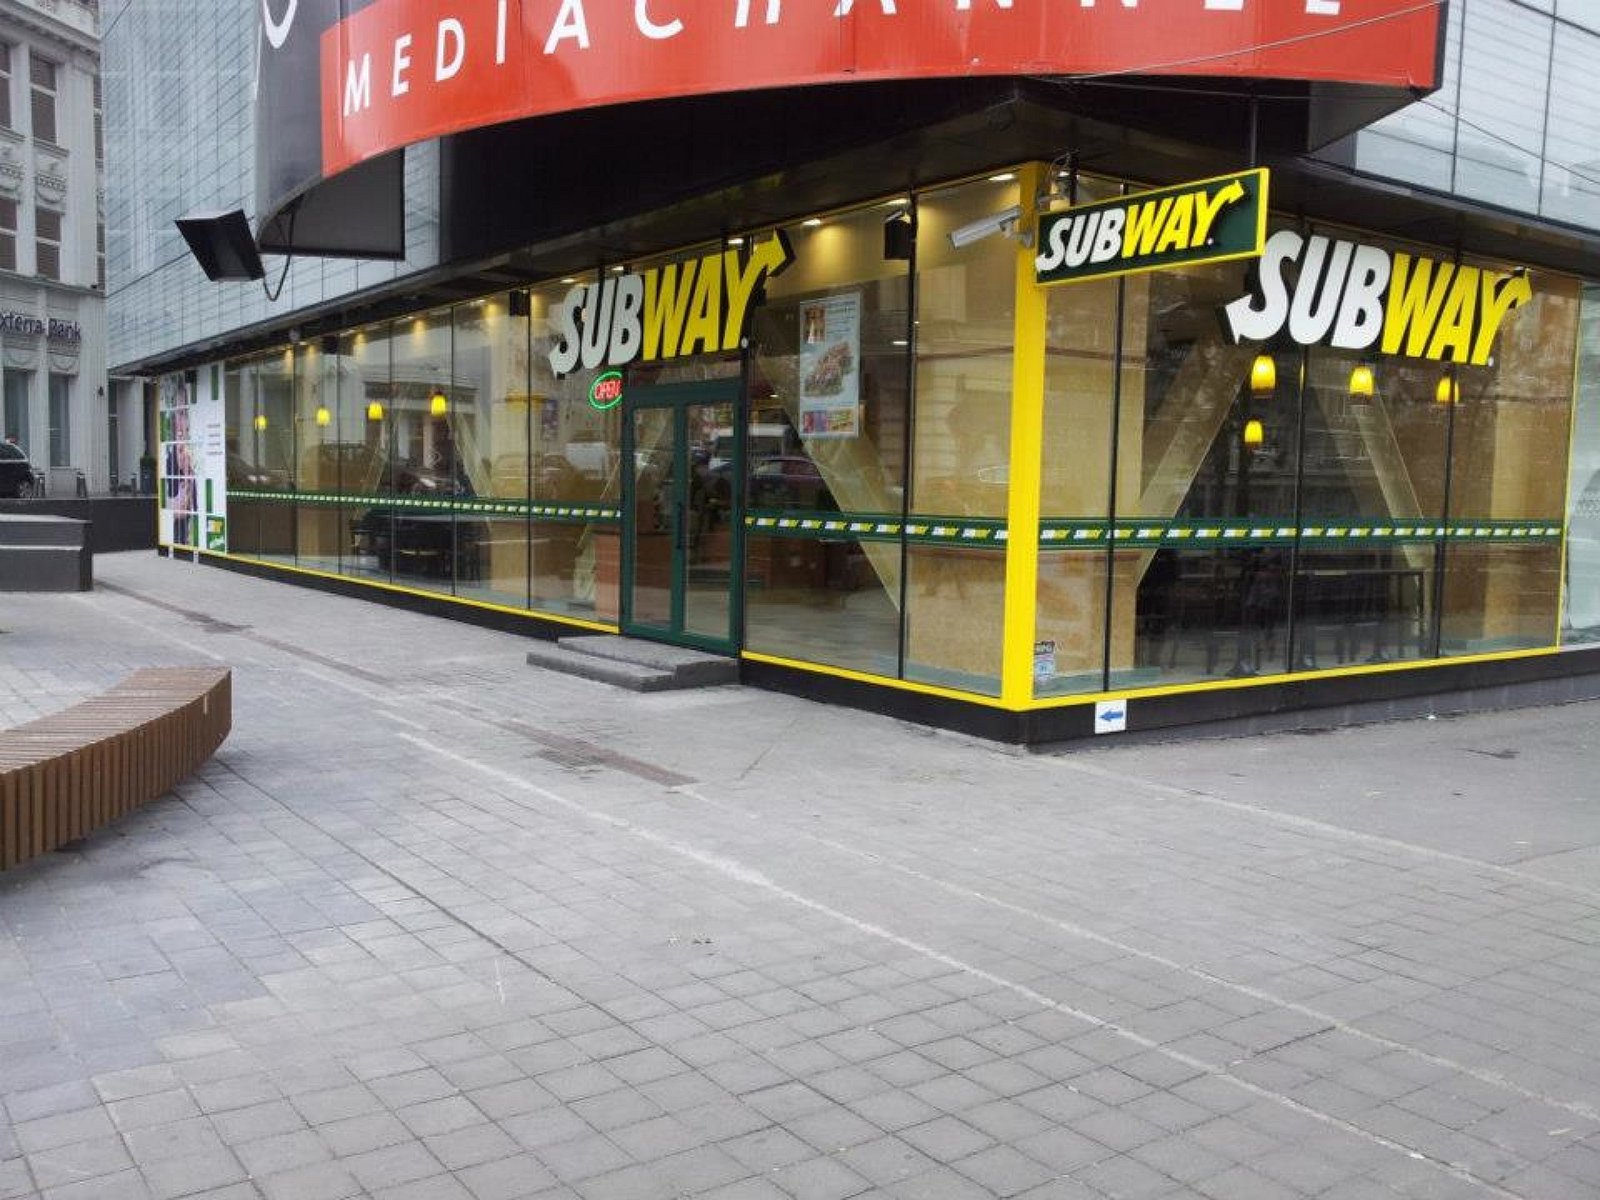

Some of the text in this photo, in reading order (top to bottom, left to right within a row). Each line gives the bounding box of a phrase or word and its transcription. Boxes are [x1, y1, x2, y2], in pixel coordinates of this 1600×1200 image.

[1035, 180, 1245, 274] SUBWAY
[48, 317, 81, 341] Bank
[549, 228, 787, 379] SUBWAY
[1225, 231, 1533, 367] SUBWAY
